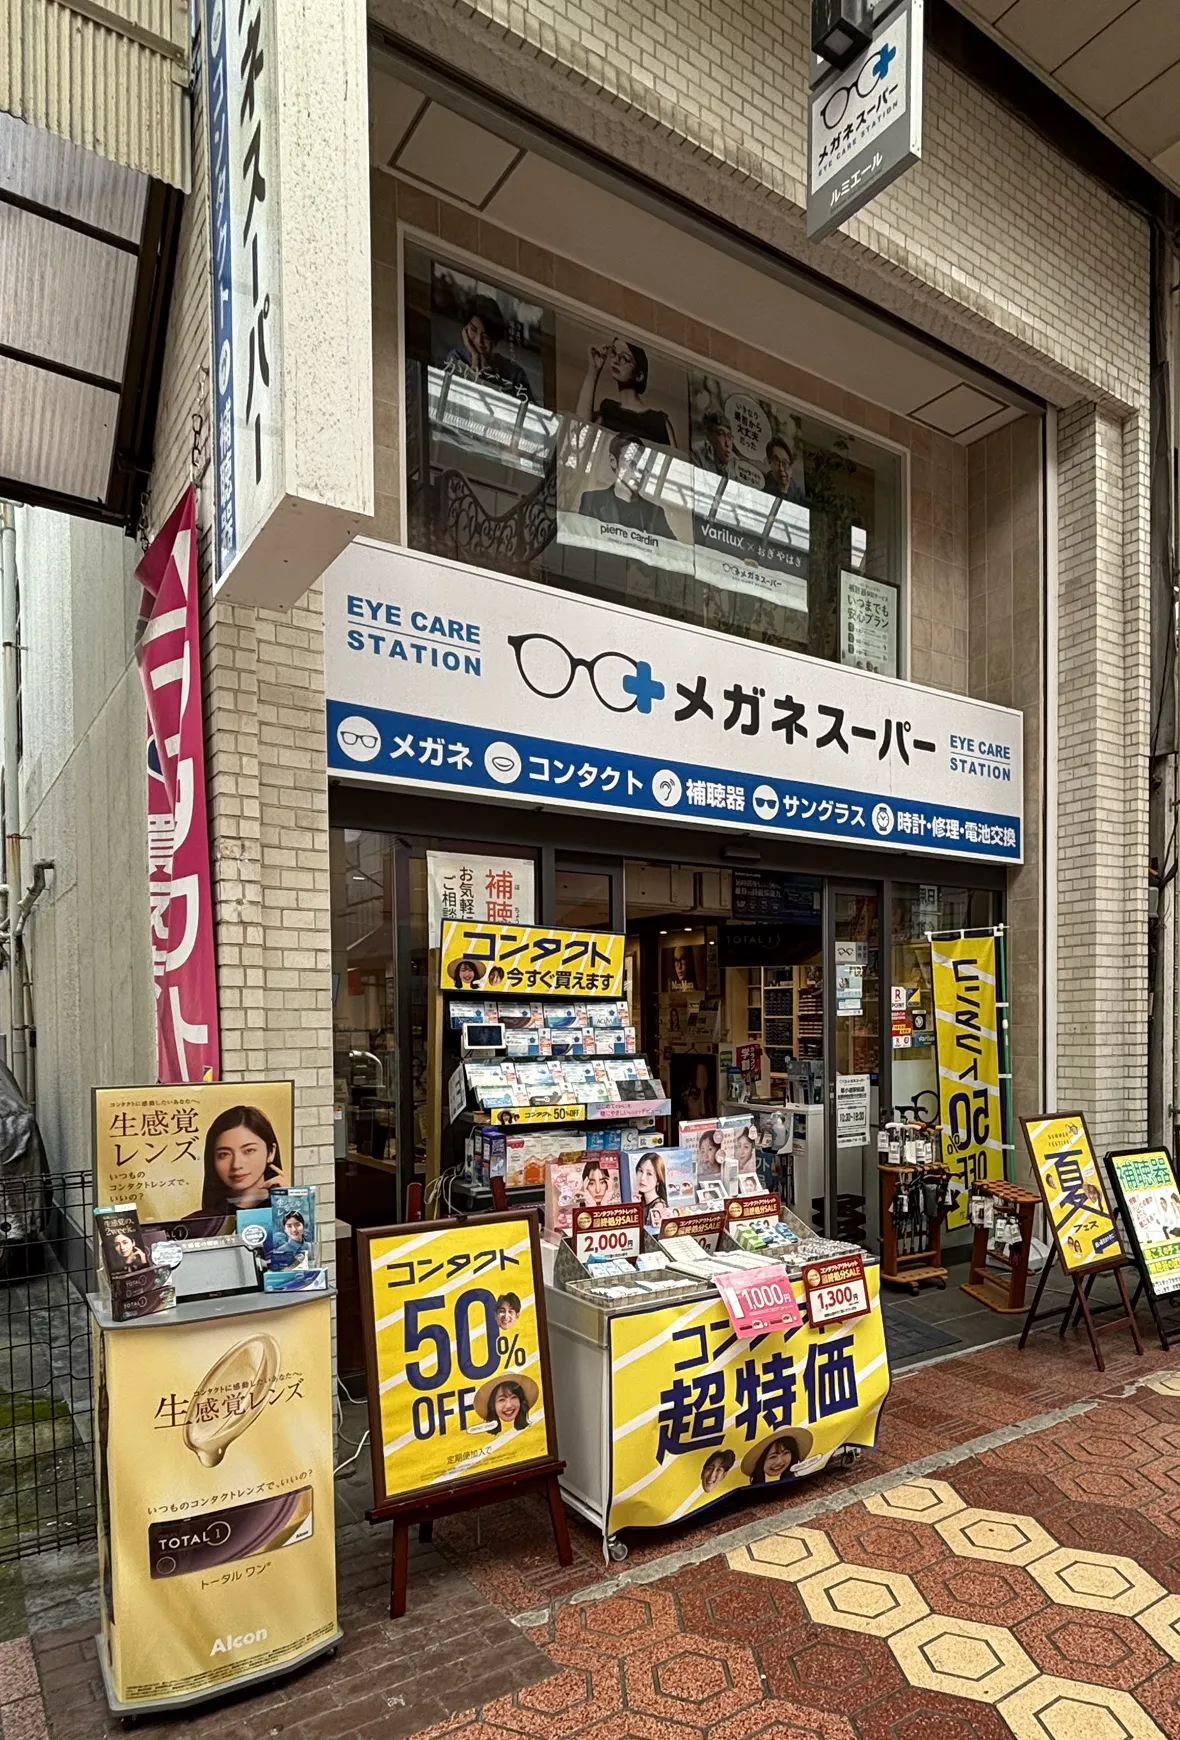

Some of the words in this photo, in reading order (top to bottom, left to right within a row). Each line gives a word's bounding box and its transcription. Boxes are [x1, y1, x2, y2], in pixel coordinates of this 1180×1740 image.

[818, 83, 899, 166] メガネスーパー
[818, 161, 833, 177] EYE
[836, 137, 857, 160] CARE
[860, 100, 899, 138] STATION
[212, 57, 230, 329] コンタクト
[830, 152, 884, 207] ルミエール
[737, 424, 759, 442] 大丈夫
[600, 524, 628, 539] pierre
[630, 529, 659, 548] cardin
[701, 524, 745, 549] Varilux
[757, 546, 803, 568] おぎやはぎ
[740, 570, 782, 587] メガネスーパー
[347, 595, 402, 627] EYE
[410, 611, 481, 645] CARE
[847, 594, 889, 618] いつまでも
[847, 607, 889, 629] 安心プラン
[347, 629, 482, 677] STATION
[674, 675, 937, 766] メガネスーパー
[389, 733, 474, 771] メガネ
[949, 734, 975, 753] EYE
[978, 741, 1011, 760] CARE
[528, 755, 644, 796] コンタクト
[949, 757, 1012, 782] STATION
[685, 777, 746, 812] 補聴器
[782, 794, 866, 828] サングラス
[896, 811, 1017, 849] 時計・修理・電池交換
[463, 931, 612, 968] コンタクト
[727, 935, 764, 945] TOTAL
[507, 968, 615, 991] 今すぐ買えます
[109, 1107, 200, 1138] 生感覚
[524, 1111, 552, 1119] コンタクト
[114, 1136, 200, 1168] レンズ
[109, 1171, 146, 1181] いつもの
[109, 1179, 190, 1192] コンタクトレンズで、
[1116, 1157, 1172, 1191] 補聴器
[1044, 1149, 1112, 1233] 夏
[593, 1208, 639, 1218] コンタクトアウトレット
[1073, 1220, 1100, 1233] フェス
[584, 1231, 633, 1253] 2,000円
[386, 1248, 520, 1288] コンタクト
[123, 1301, 140, 1309] TOTAL
[817, 1286, 859, 1311] 1,300円
[154, 1377, 305, 1430] 生感覚レンズ
[411, 1386, 477, 1441] OFF
[655, 1334, 860, 1466] 超特価
[158, 1531, 211, 1550] TOTAL
[200, 1571, 243, 1590] トータル
[209, 1627, 268, 1657] Alcon
